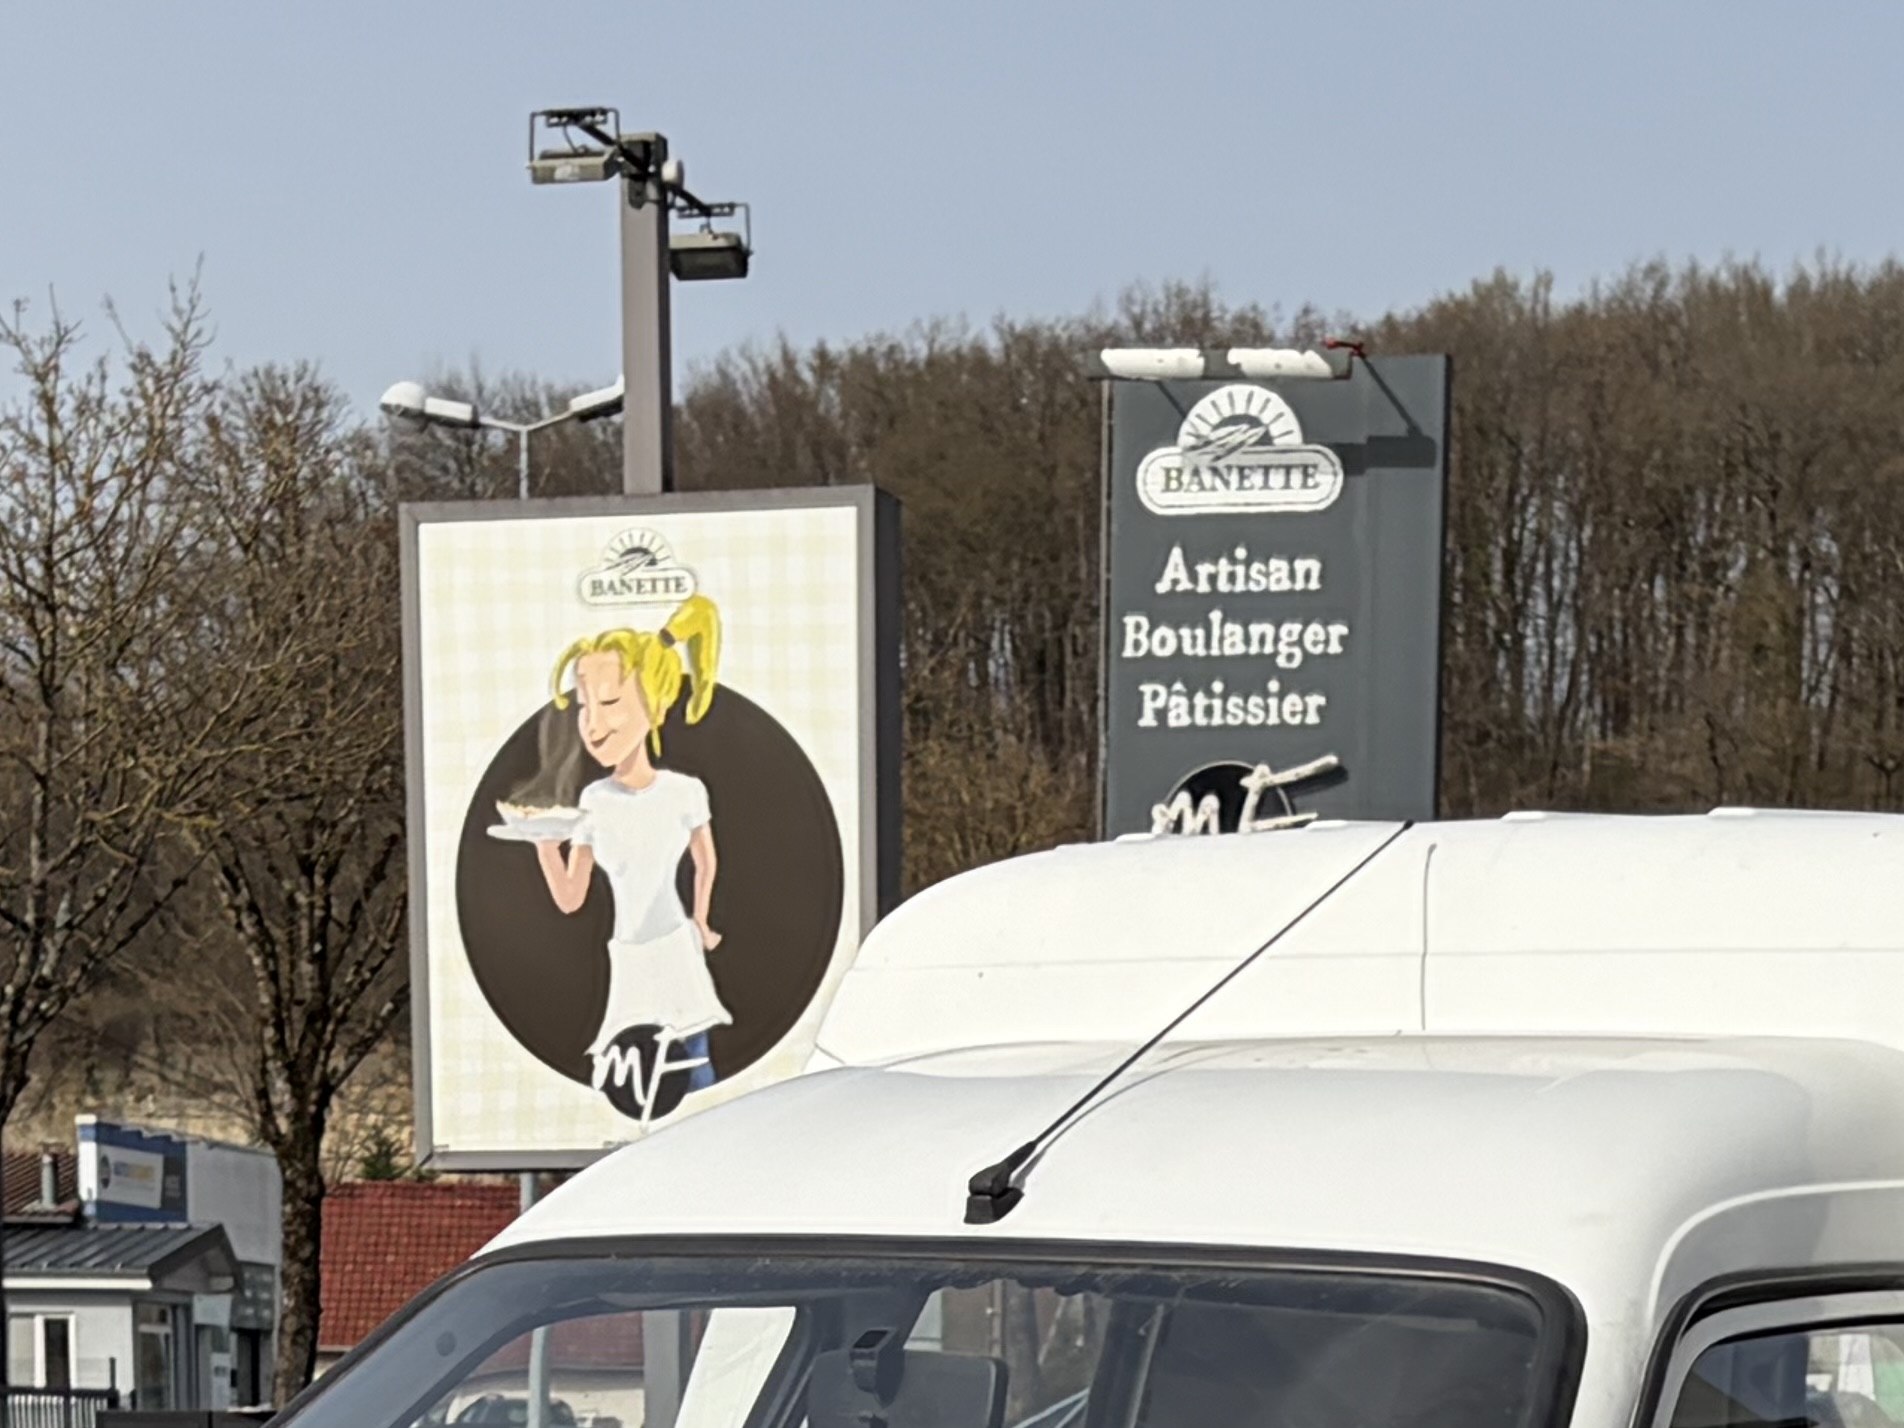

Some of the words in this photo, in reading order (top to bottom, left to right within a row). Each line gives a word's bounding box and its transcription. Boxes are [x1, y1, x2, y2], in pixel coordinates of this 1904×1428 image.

[1161, 464, 1321, 494] BANETTE
[590, 576, 688, 597] BANETTE
[1154, 541, 1322, 595] Artisan
[1122, 609, 1350, 669] Boulanger
[1137, 677, 1327, 728] Pâtissier
